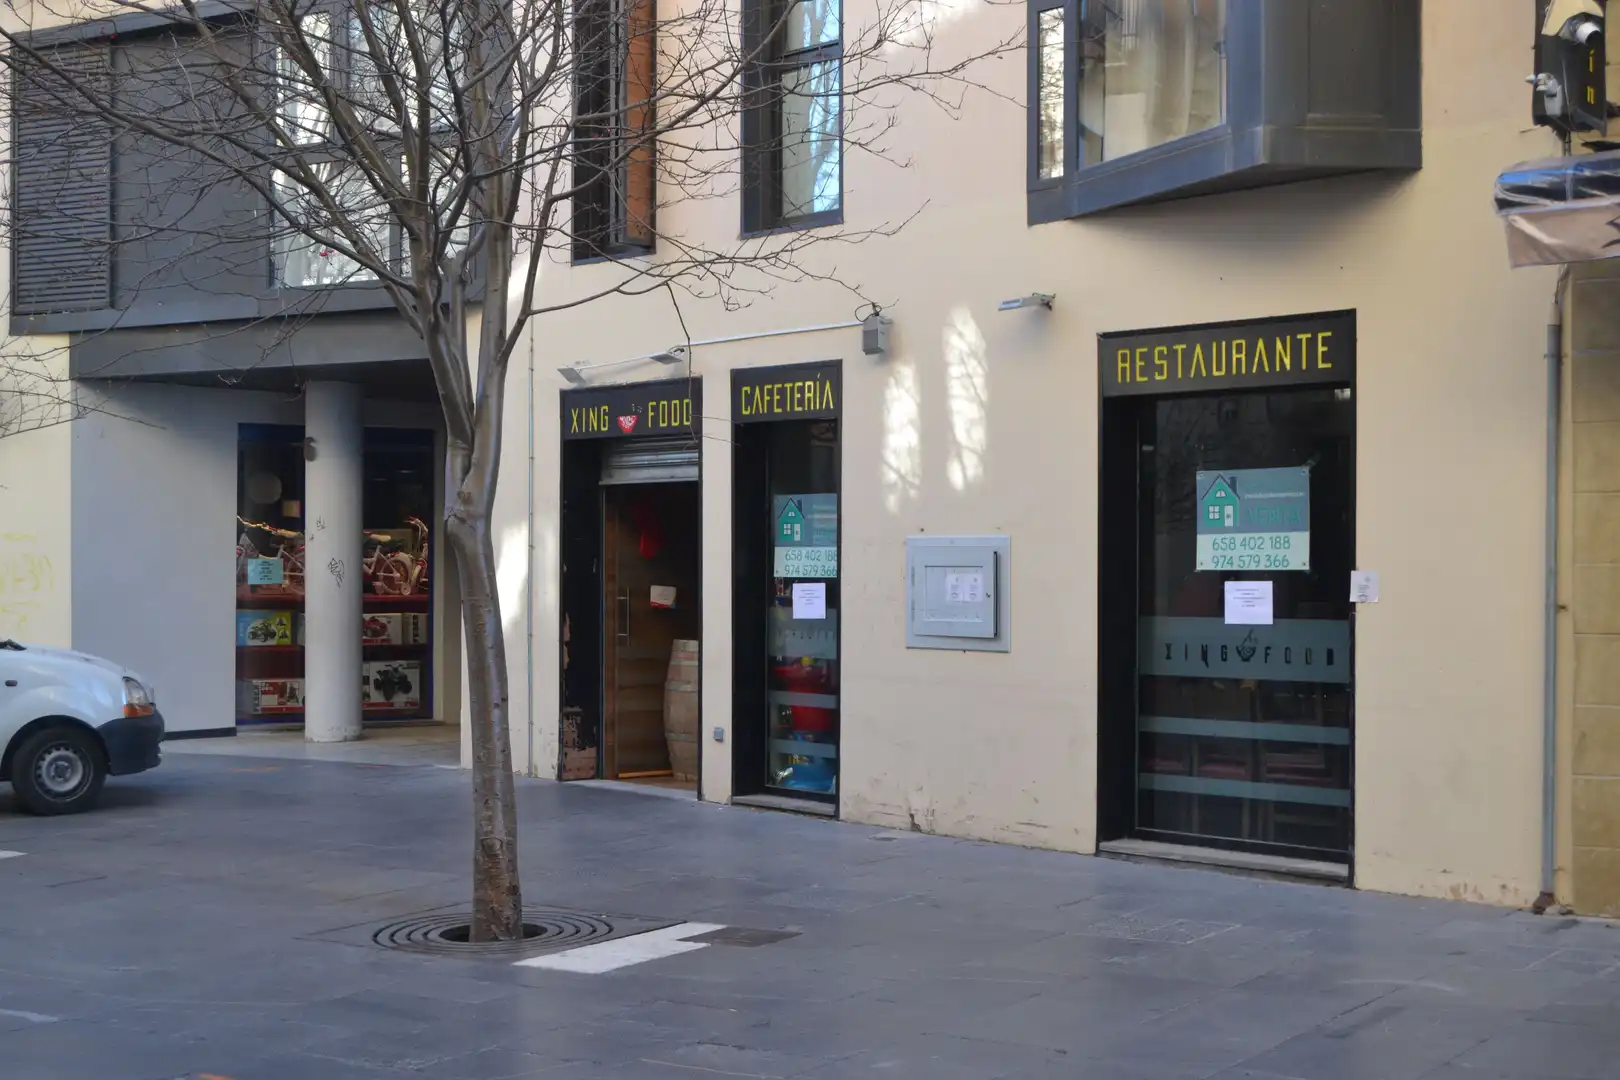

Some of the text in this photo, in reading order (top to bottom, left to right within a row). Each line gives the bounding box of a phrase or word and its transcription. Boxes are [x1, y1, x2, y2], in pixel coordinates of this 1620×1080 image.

[1117, 331, 1333, 384] RESTAURANTE
[741, 373, 834, 415] CAFETERÍA
[570, 405, 609, 434] XING
[647, 398, 692, 428] FOOD
[1247, 505, 1300, 526] VENTA
[1212, 535, 1291, 551] 658 402 188
[785, 549, 802, 562] 658
[804, 549, 821, 562] 402
[1211, 554, 1290, 568] 974 579 366
[784, 564, 837, 576] 974 579 366
[1165, 643, 1334, 668] XING FOOD
